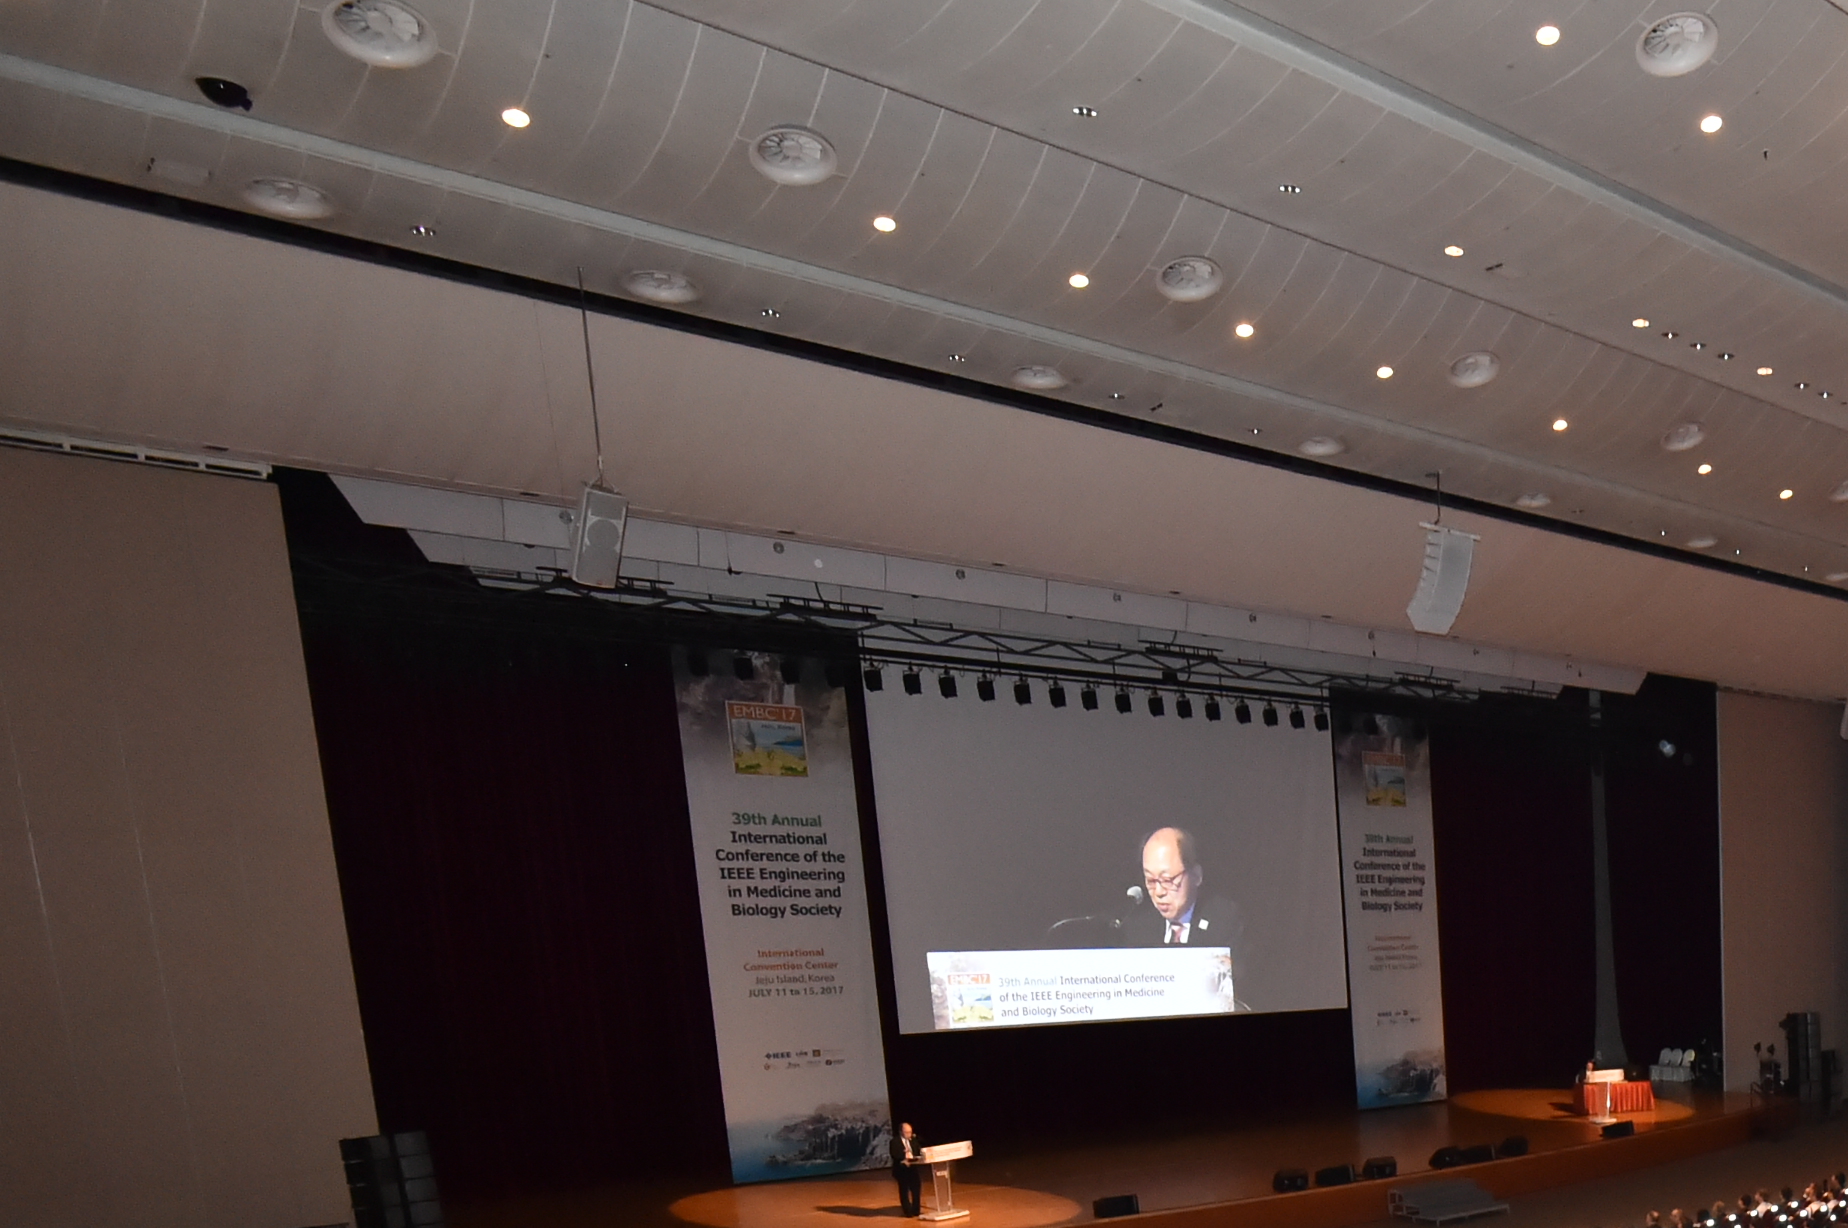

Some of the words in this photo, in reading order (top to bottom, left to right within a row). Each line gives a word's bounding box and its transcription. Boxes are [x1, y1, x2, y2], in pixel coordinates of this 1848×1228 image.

[732, 813, 767, 825] 39th
[771, 814, 822, 827] Annual
[730, 831, 827, 845] International
[716, 849, 799, 862] Conference
[804, 851, 818, 863] of
[822, 851, 845, 863] the
[1363, 847, 1416, 857] International
[1354, 861, 1401, 870] Conference
[1403, 862, 1410, 870] of
[719, 868, 755, 880] IEEE
[760, 868, 845, 883] Engineering
[1356, 874, 1375, 883] IEEE
[1378, 875, 1425, 885] Engineering
[728, 885, 742, 898] in
[747, 886, 811, 898] Medicine
[815, 886, 841, 898] and
[1360, 888, 1368, 896] in
[1371, 888, 1406, 897] Medicine
[732, 904, 786, 918] Biology
[790, 903, 842, 918] Society
[1362, 902, 1392, 912] Biology
[1394, 901, 1423, 911] Society
[758, 948, 824, 958] International
[743, 962, 803, 971] Convention
[805, 961, 838, 969] Center
[808, 974, 835, 983] Korea
[999, 977, 1021, 987] 39th
[1024, 976, 1057, 986] Annual
[1060, 974, 1121, 985] International
[1124, 974, 1175, 983] Conference
[748, 989, 772, 997] JULY
[776, 988, 786, 996] 11
[821, 986, 844, 995] 2017
[999, 992, 1009, 1002] of
[1012, 992, 1028, 1001] the
[1031, 991, 1052, 1001] IEEE
[1056, 990, 1111, 1002] Engineering
[1114, 988, 1122, 997] in
[1125, 987, 1165, 997] Medicine
[1001, 1007, 1019, 1017] and
[1022, 1006, 1057, 1018] Biology
[1060, 1004, 1094, 1015] Society
